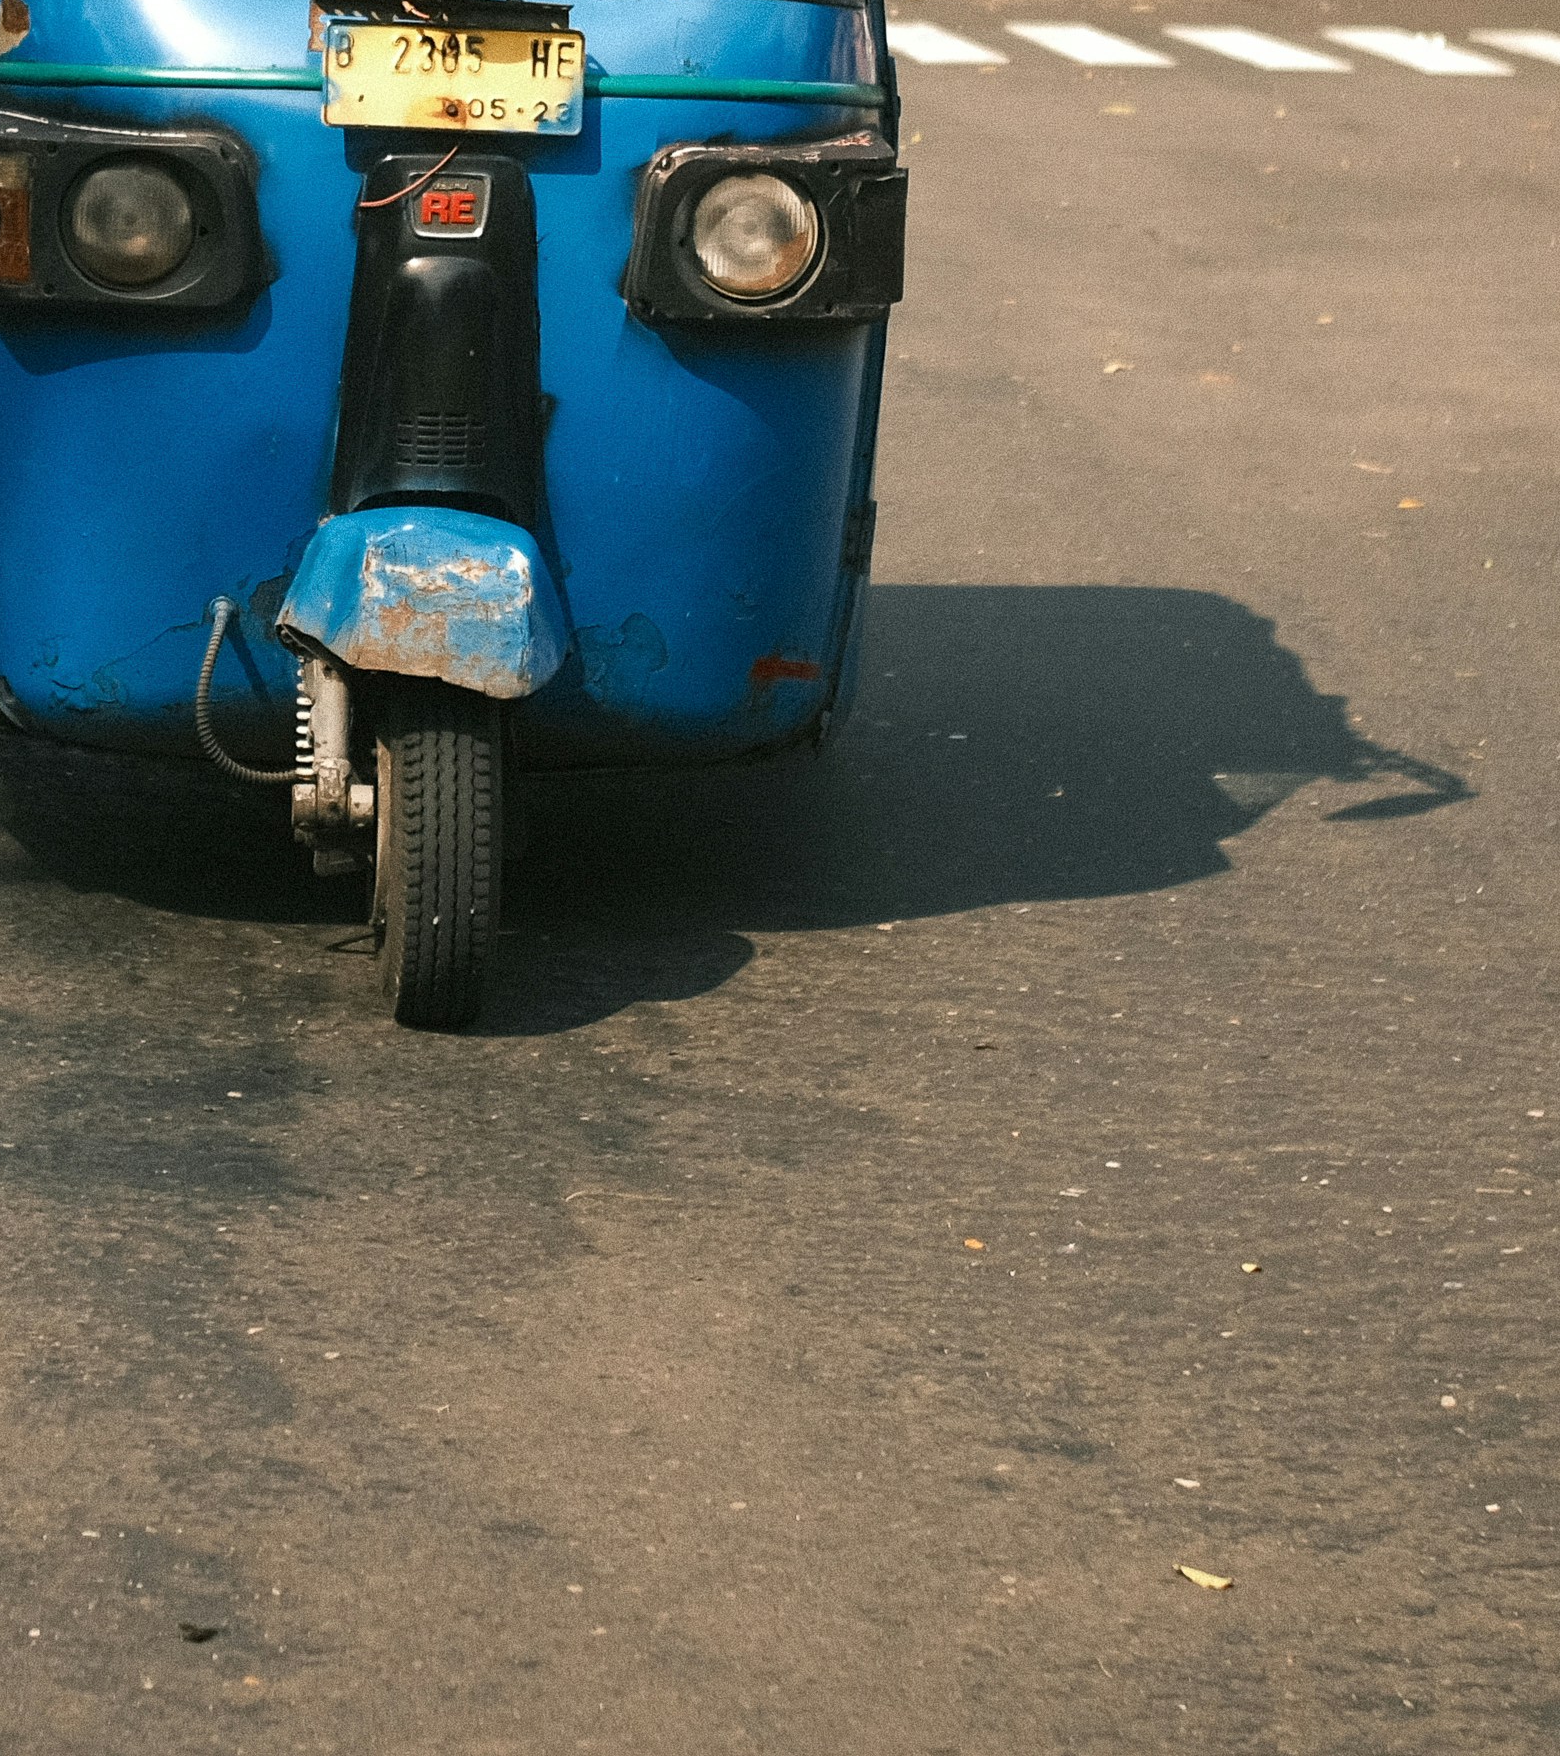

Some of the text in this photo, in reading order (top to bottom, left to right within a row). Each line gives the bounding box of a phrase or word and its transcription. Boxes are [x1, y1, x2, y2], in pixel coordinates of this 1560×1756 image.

[336, 33, 355, 68] B
[531, 39, 576, 80] HE
[422, 191, 476, 224] RE
